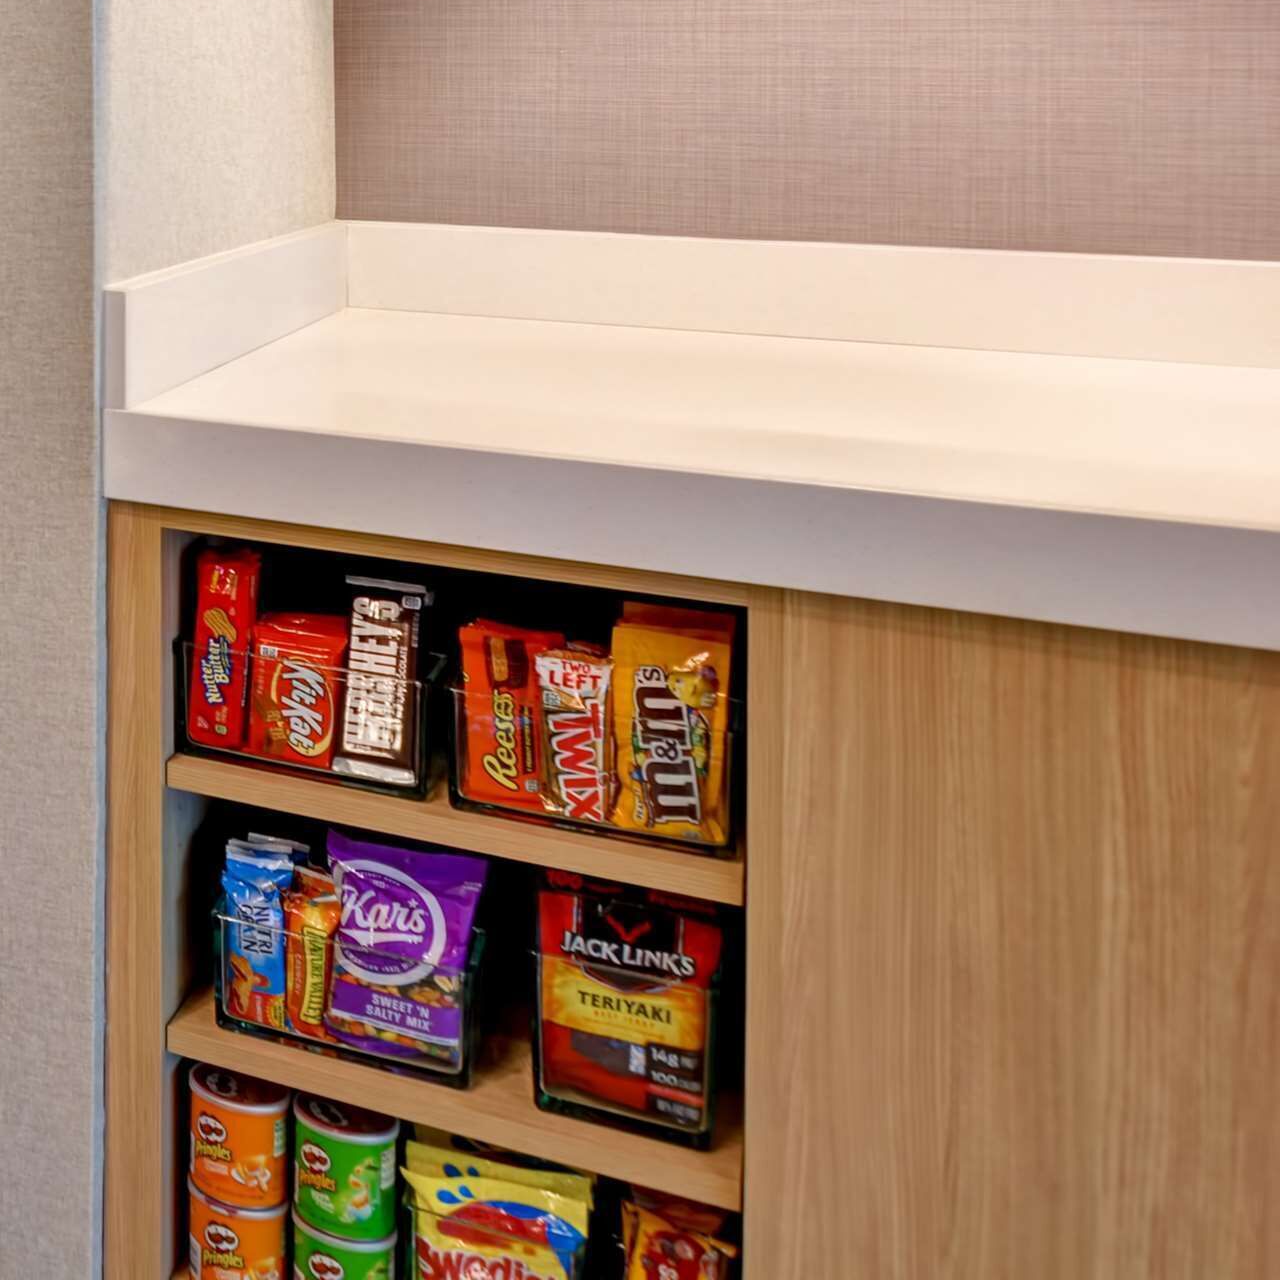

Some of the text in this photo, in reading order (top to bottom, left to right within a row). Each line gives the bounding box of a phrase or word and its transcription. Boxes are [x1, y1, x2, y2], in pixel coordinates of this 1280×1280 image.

[207, 638, 230, 684] Butter
[561, 660, 590, 674] TWO
[201, 659, 223, 704] Nutter
[548, 672, 602, 689] LEFT
[281, 659, 325, 749] Kit Kat
[550, 701, 604, 822] TWIX
[253, 906, 273, 954] NUTRI
[560, 931, 622, 965] JACK
[304, 929, 326, 1022] NATURE VALLEY
[365, 1004, 431, 1032] SALTY MIX
[372, 993, 413, 1014] SWEET
[578, 990, 672, 1025] TERIYAKI
[195, 1140, 232, 1160] Pringles
[203, 1249, 244, 1269] Pringles
[416, 1235, 557, 1280] Swedi
